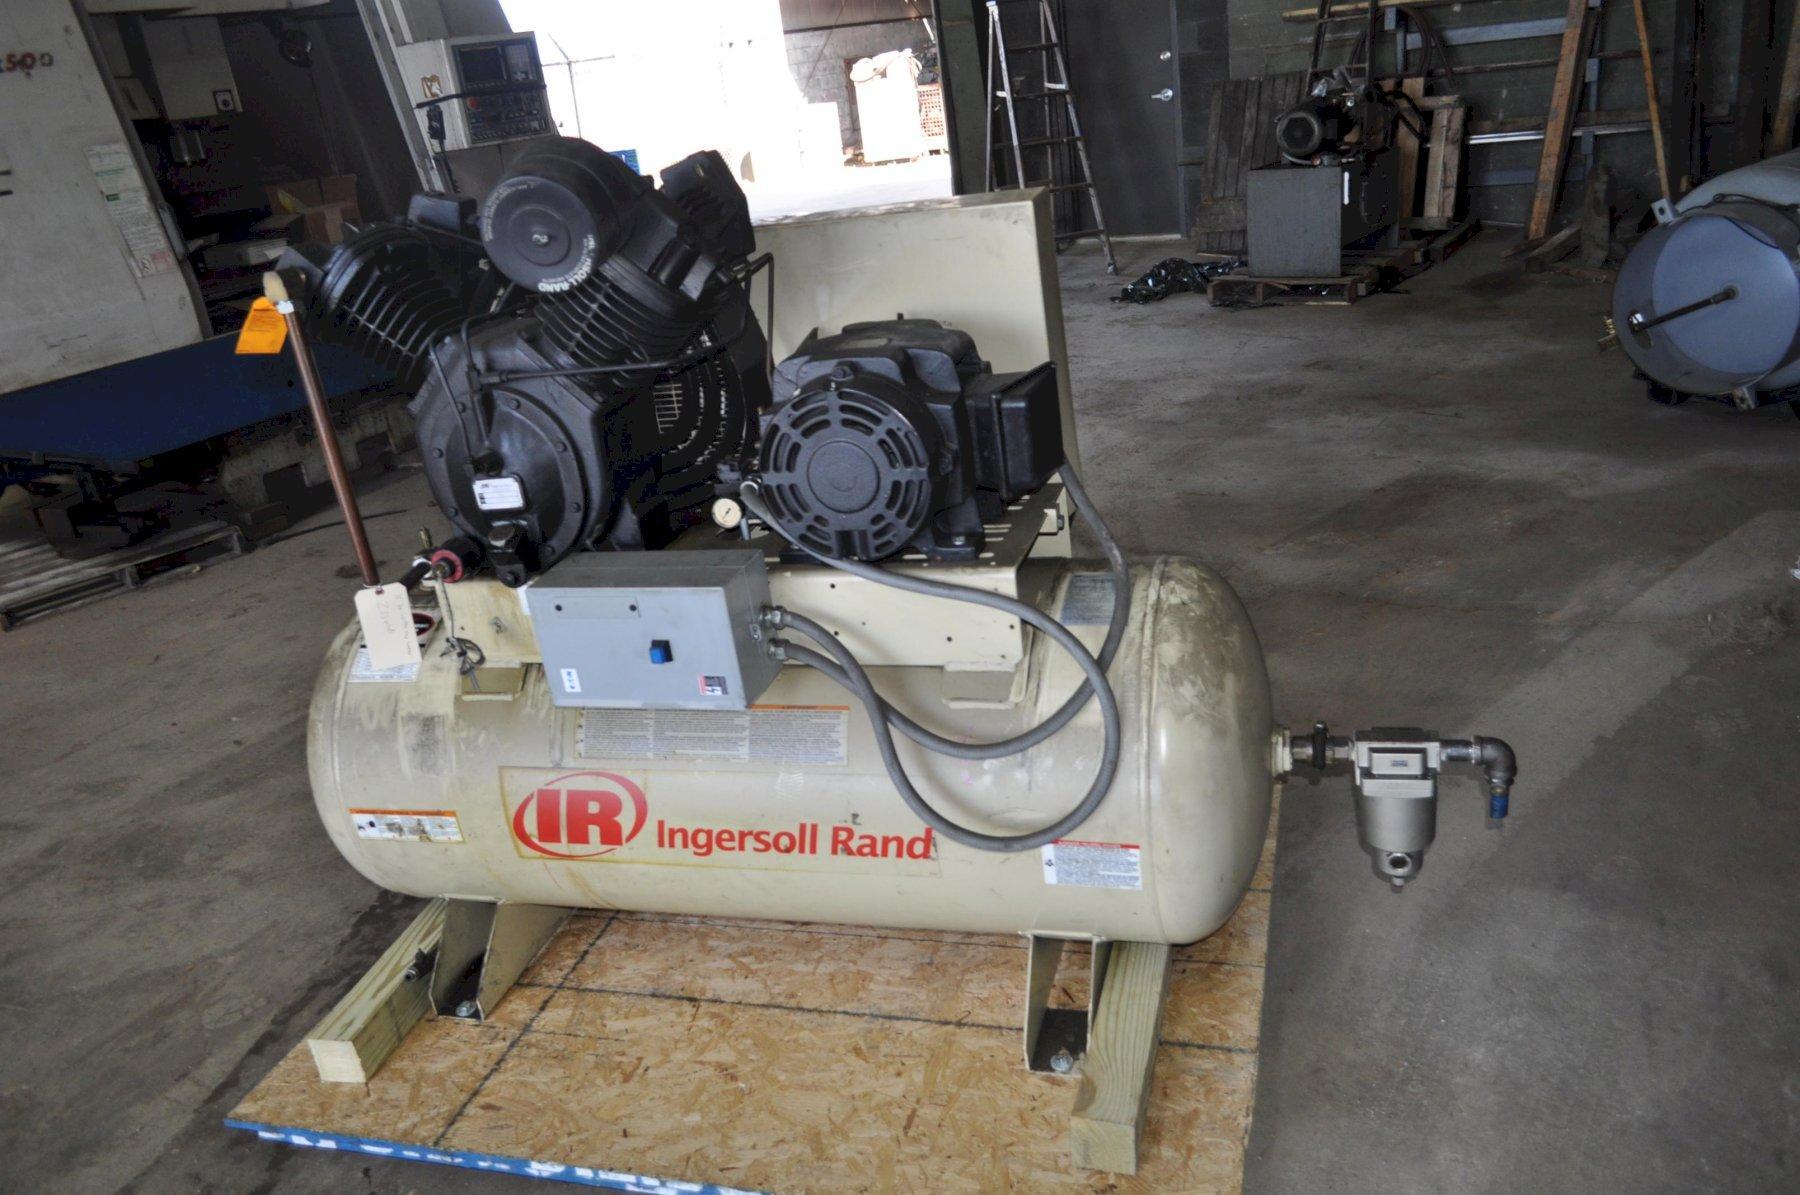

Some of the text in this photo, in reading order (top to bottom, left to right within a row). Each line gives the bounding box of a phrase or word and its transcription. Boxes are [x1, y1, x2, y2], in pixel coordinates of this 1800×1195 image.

[536, 788, 624, 847] IR
[656, 820, 934, 860] Ingersoll Rand
